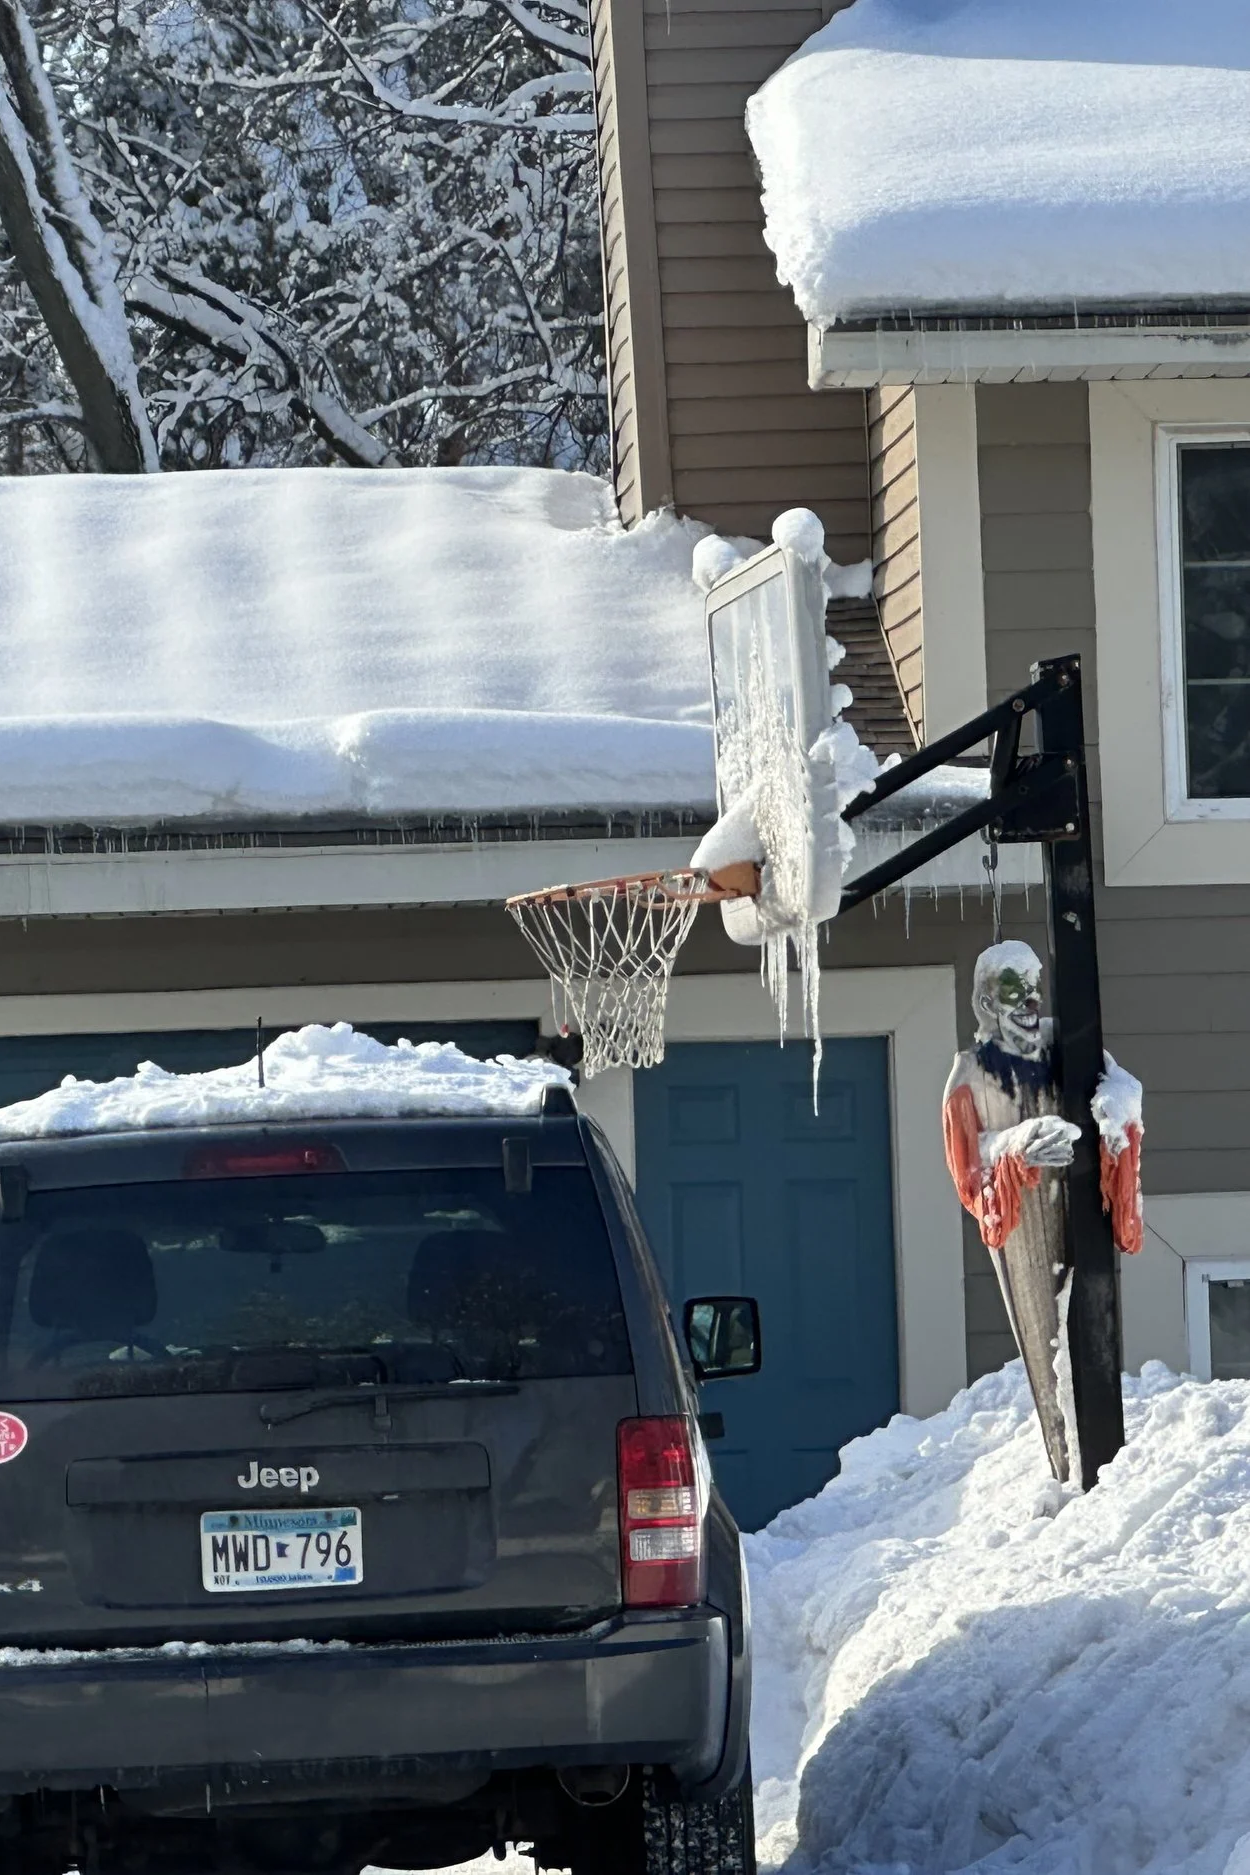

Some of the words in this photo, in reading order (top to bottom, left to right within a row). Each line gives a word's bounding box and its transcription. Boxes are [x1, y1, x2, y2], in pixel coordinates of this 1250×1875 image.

[237, 1461, 320, 1492] Jeep
[244, 1513, 319, 1530] Minnesota
[211, 1534, 271, 1572] MWD
[296, 1530, 352, 1570] 796
